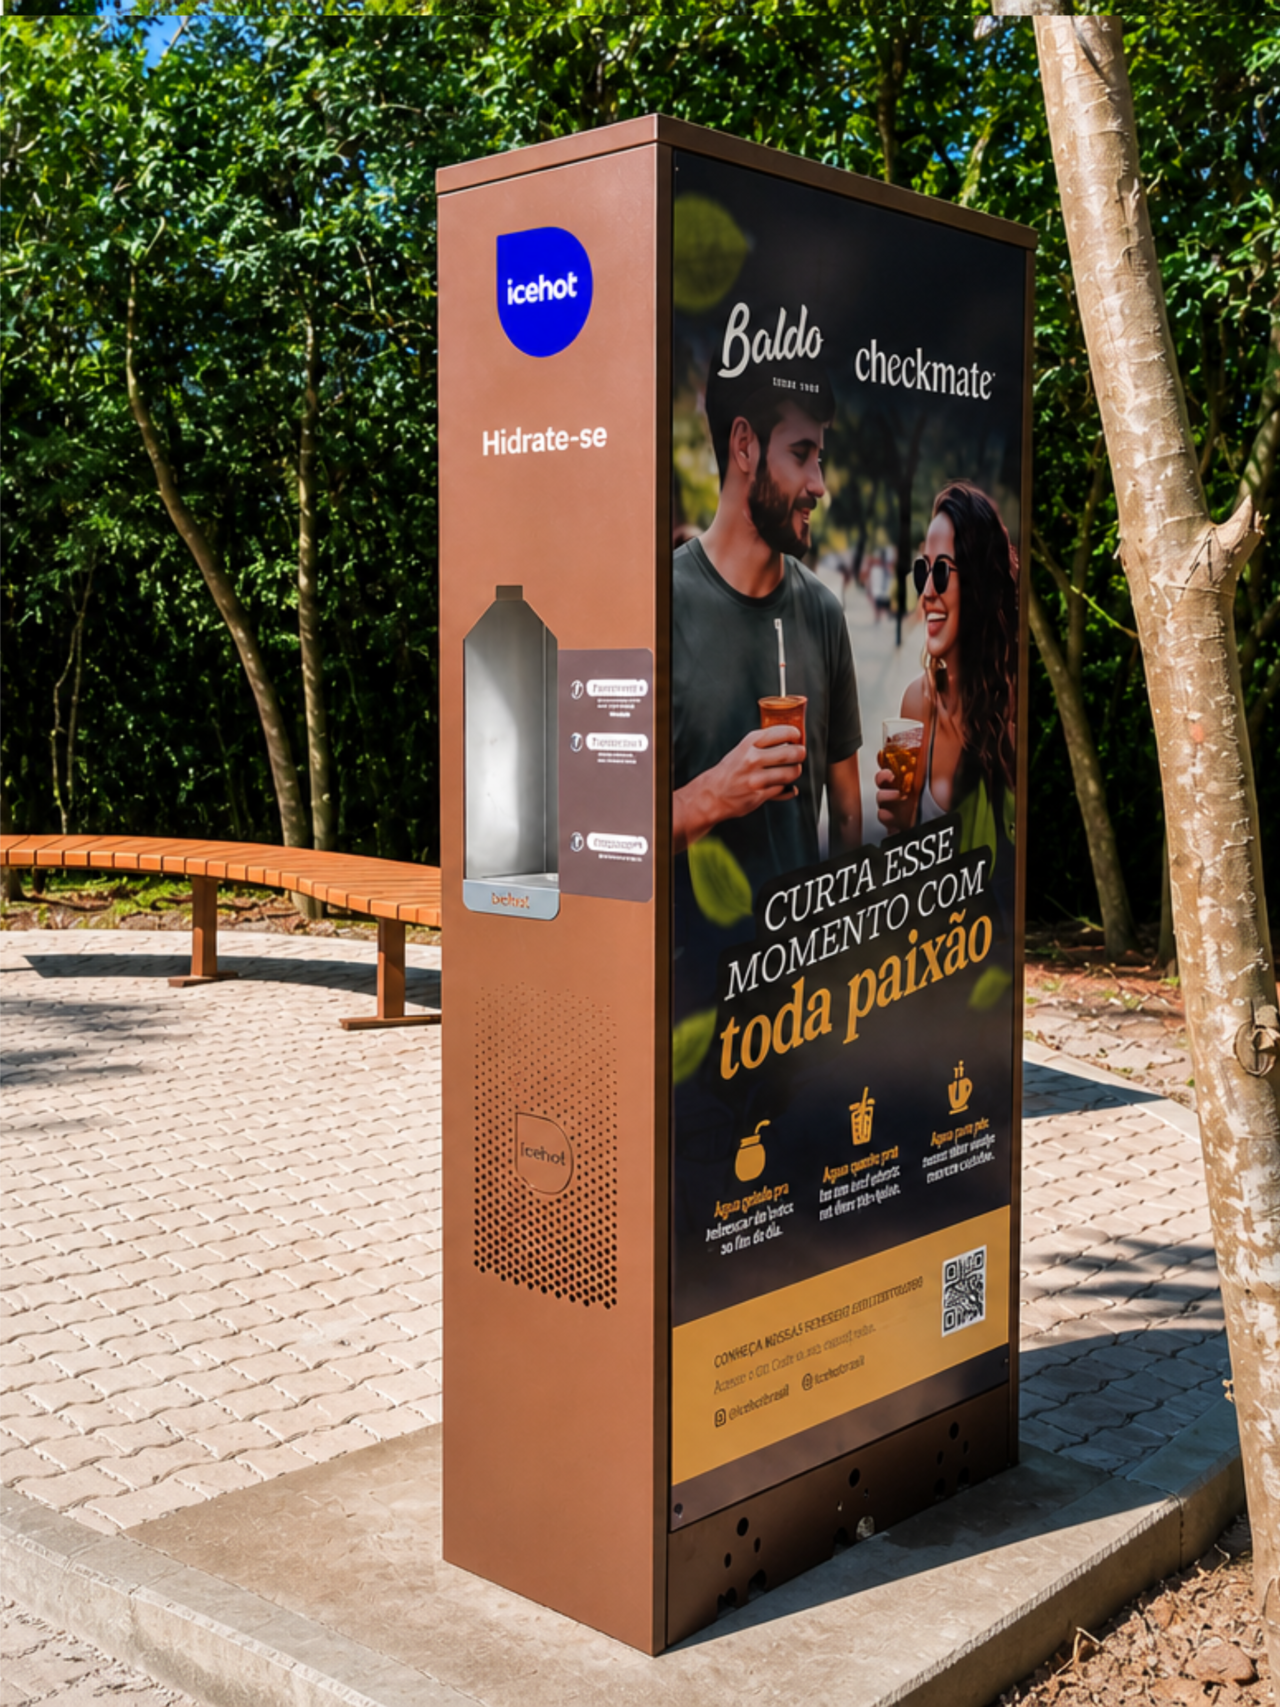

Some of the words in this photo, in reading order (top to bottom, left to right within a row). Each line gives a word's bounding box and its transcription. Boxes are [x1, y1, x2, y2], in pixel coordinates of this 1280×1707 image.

[507, 271, 578, 305] icehot
[717, 302, 823, 378] Baldo
[855, 339, 993, 400] checkmate
[482, 426, 608, 456] Hidrate-se
[764, 858, 877, 931] CURTA
[882, 826, 955, 886] ESSE
[724, 893, 910, 1001] MOMENTO
[917, 860, 986, 917] COM
[720, 976, 833, 1080] toda
[842, 908, 993, 1044] paixão
